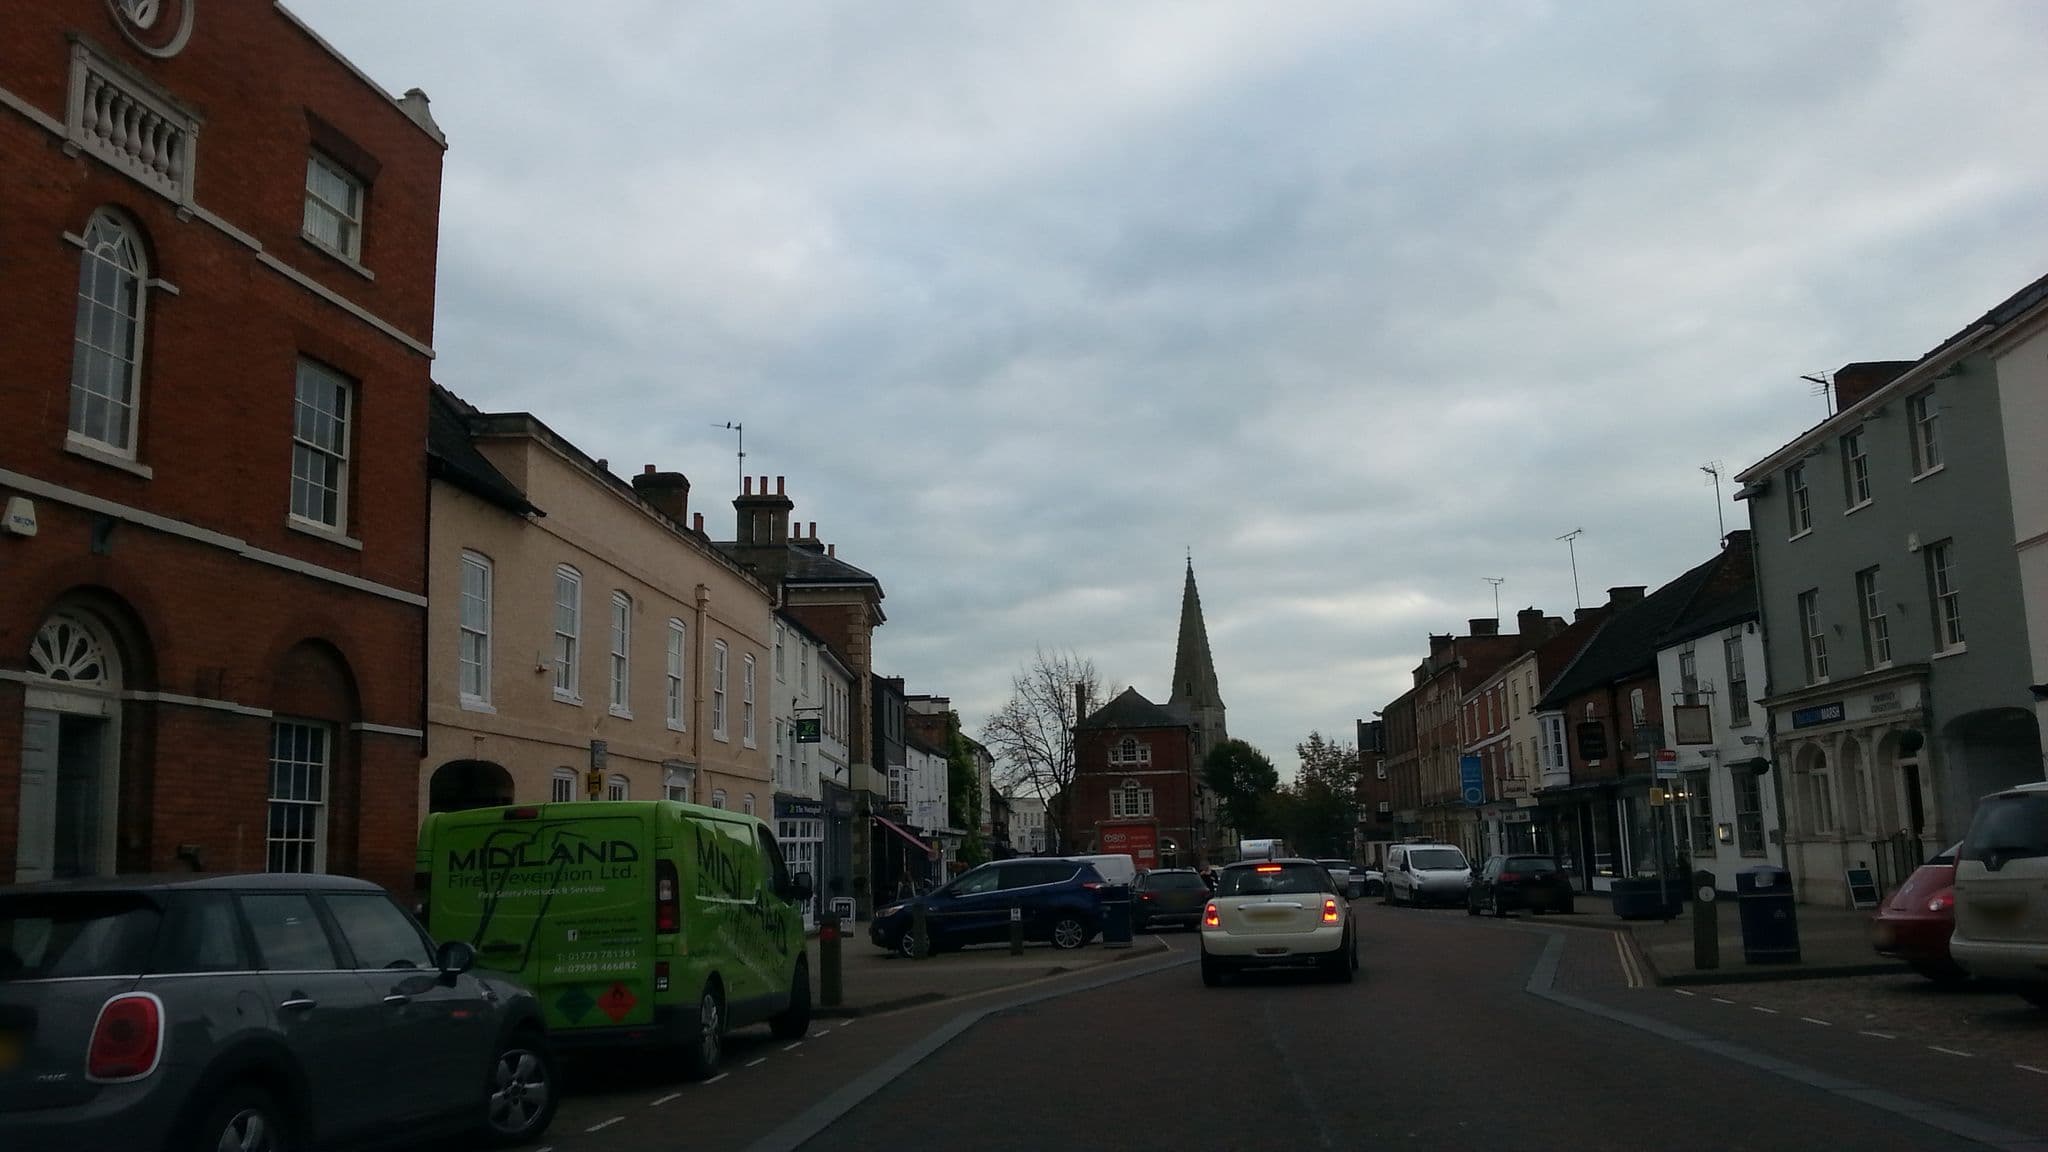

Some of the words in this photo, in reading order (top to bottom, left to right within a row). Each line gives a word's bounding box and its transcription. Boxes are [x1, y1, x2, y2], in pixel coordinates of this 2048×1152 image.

[1821, 705, 1841, 720] MARSH
[449, 840, 639, 872] MIDLAND
[448, 873, 484, 889] Fire
[491, 867, 593, 885] Prevention
[600, 863, 638, 881] Ltd.
[569, 885, 607, 895] Services
